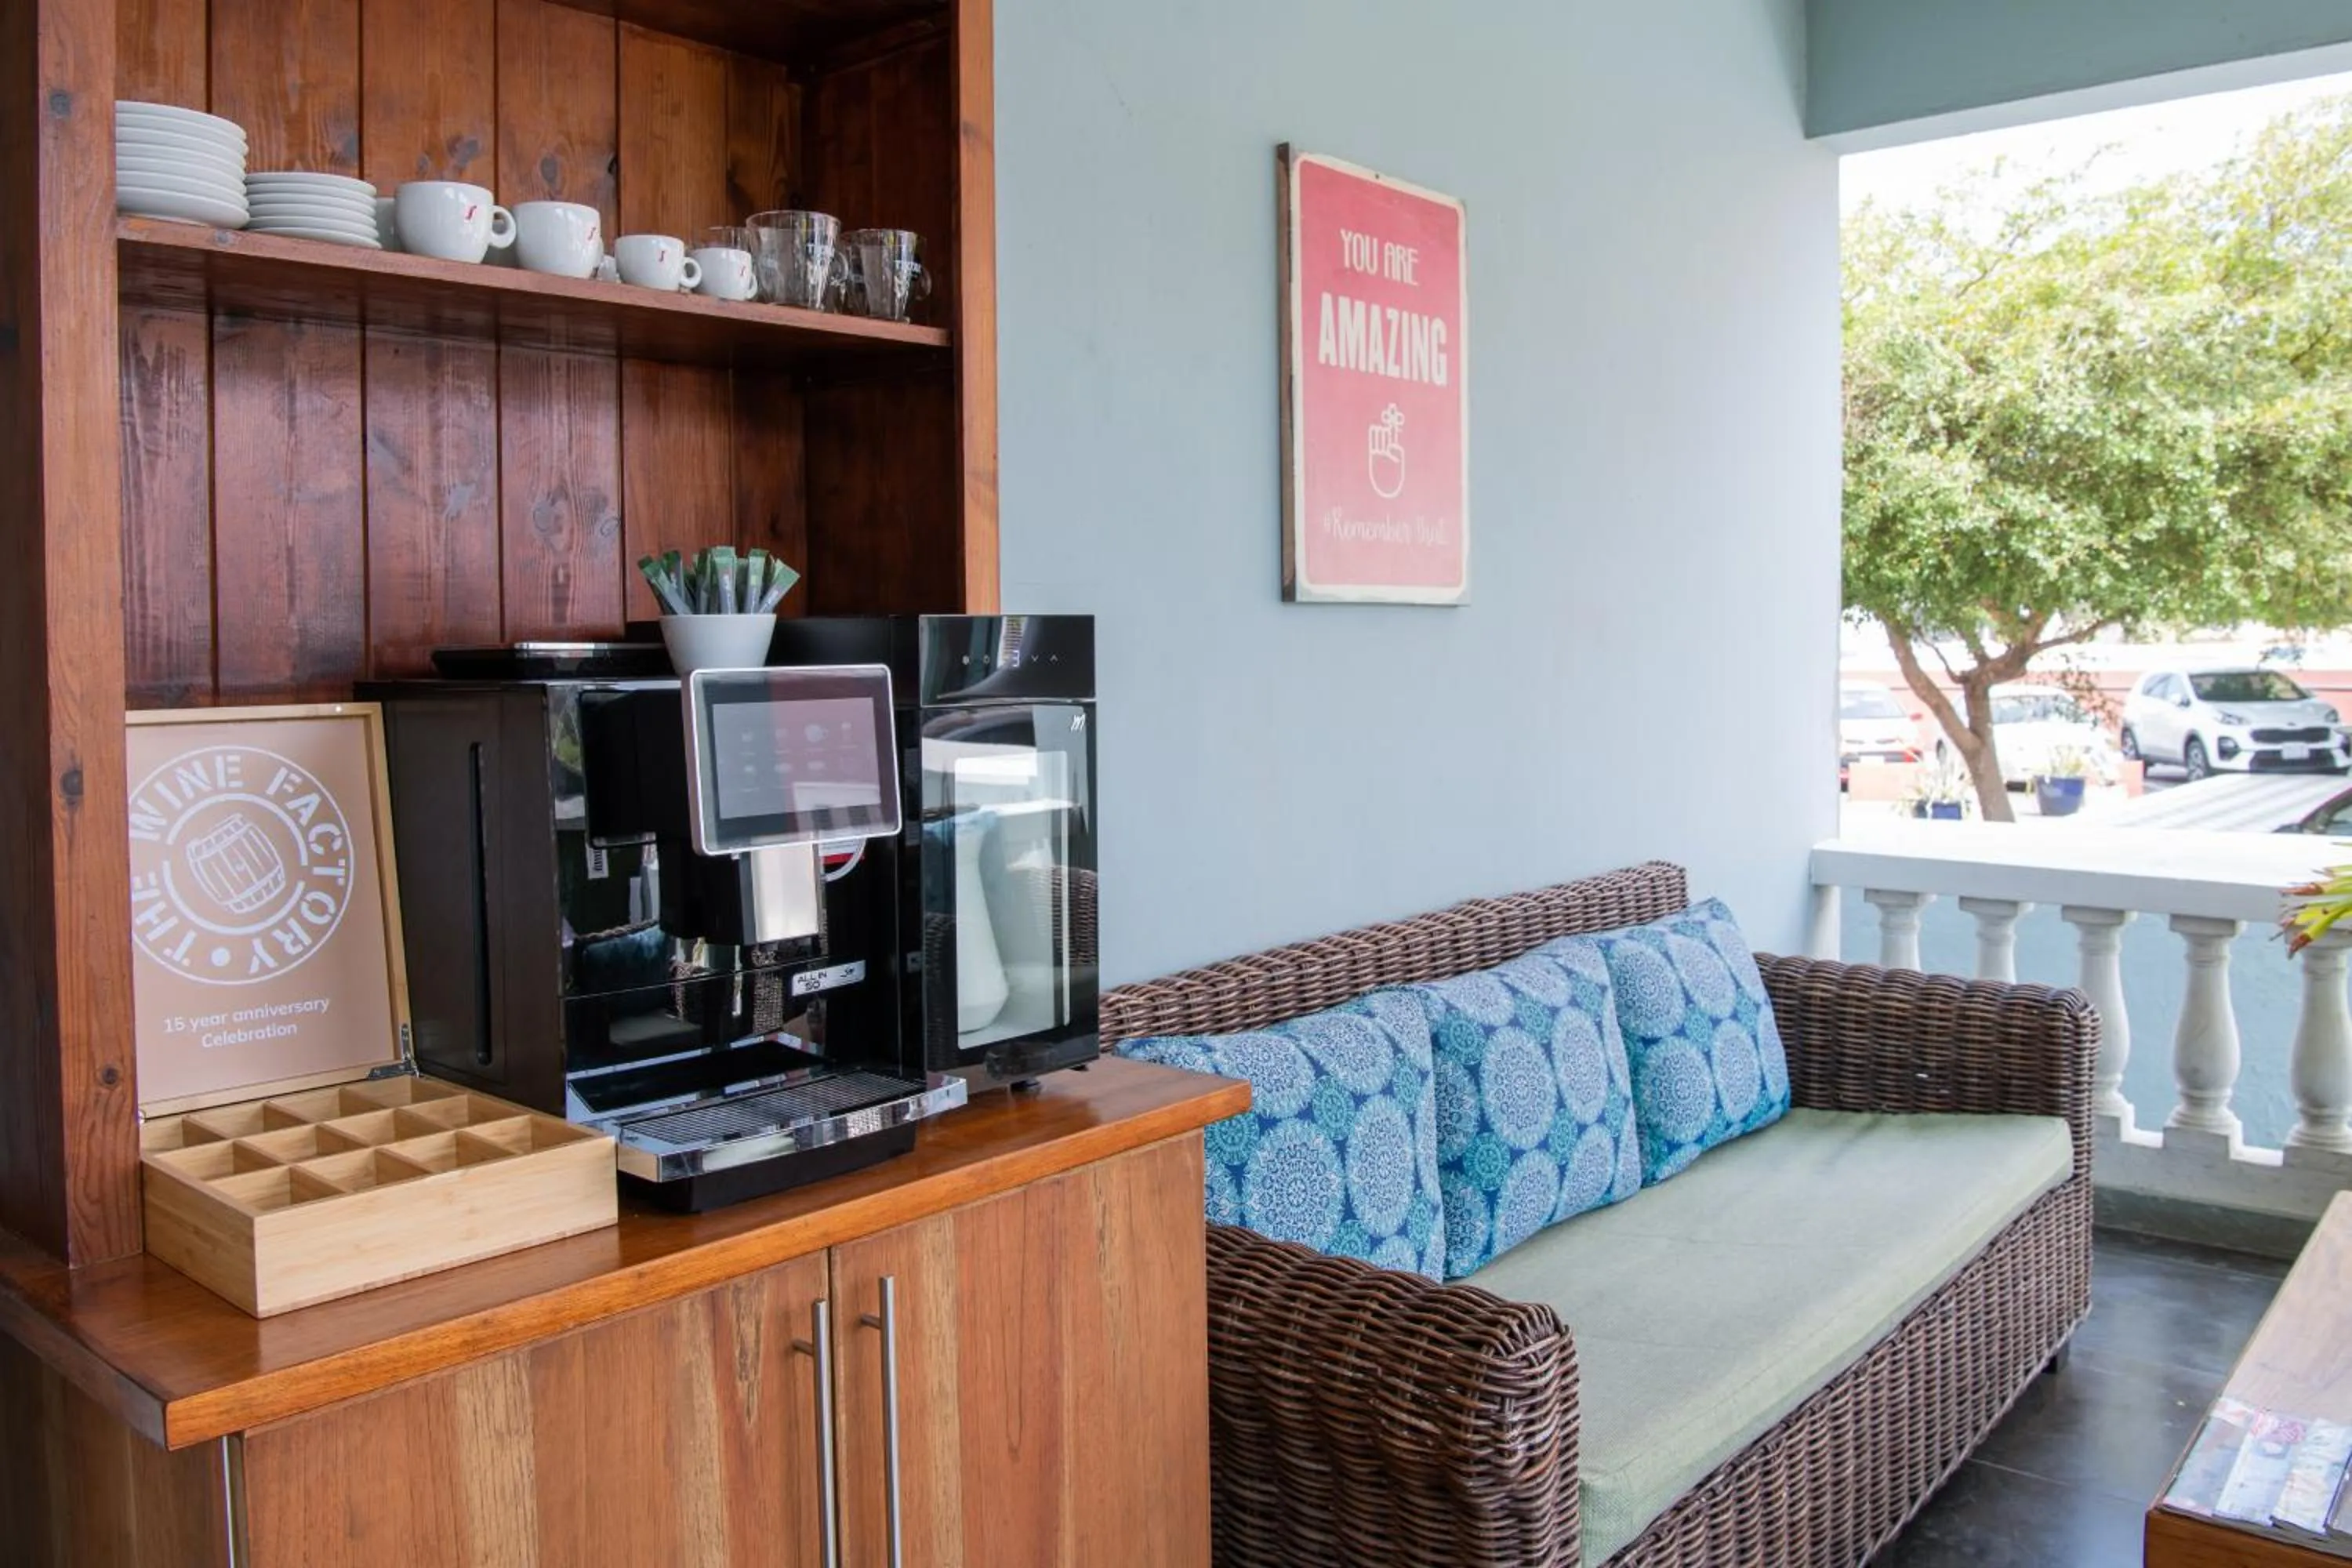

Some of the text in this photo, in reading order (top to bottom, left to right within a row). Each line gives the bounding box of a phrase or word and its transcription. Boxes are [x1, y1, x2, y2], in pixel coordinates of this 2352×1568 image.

[1340, 228, 1418, 286] YOU ARE
[1319, 292, 1447, 386] AMAZING
[129, 755, 345, 975] THE WINE FACTORY
[164, 998, 330, 1033] 15 year anniversary
[201, 1022, 297, 1047] Celebration
